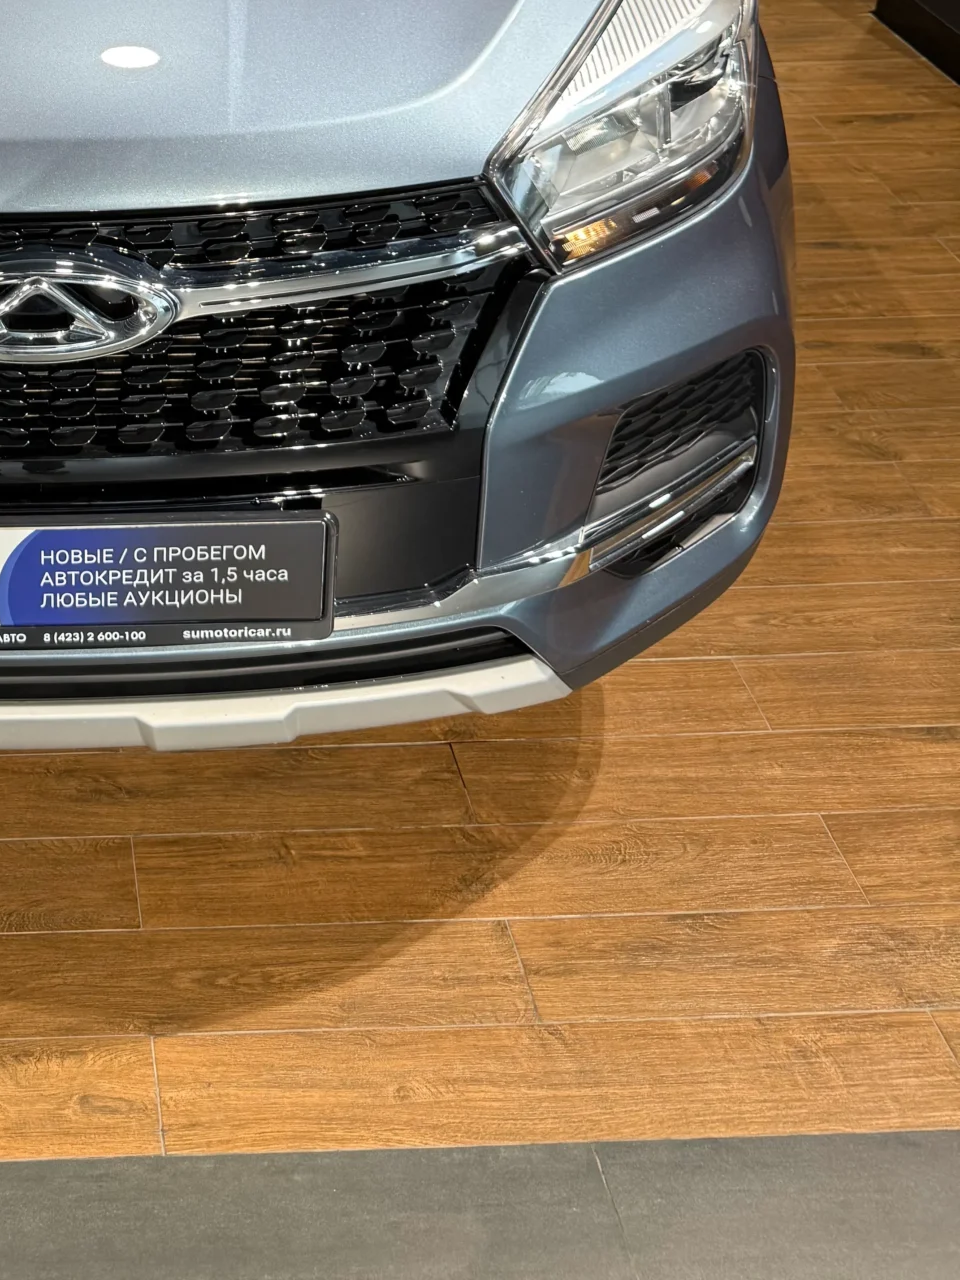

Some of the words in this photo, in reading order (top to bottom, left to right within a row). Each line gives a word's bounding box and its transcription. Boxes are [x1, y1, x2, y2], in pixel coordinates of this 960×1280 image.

[40, 548, 113, 565] НОВЫЕ
[119, 548, 127, 564] /
[133, 547, 148, 562] С
[153, 545, 266, 563] ПРОБЕГОМ
[40, 568, 178, 588] АВТОКРЕДИТ
[182, 571, 204, 584] за
[211, 567, 238, 585] 1,5
[243, 567, 289, 582] часа
[40, 591, 118, 608] ЛЮБЫЕ
[123, 589, 242, 608] АУКЦИОНЫ
[43, 632, 51, 643] 8
[54, 631, 84, 644] (423)
[86, 631, 95, 642] 2
[97, 630, 147, 642] 600-100
[183, 627, 291, 640] sumotoricar.ru
